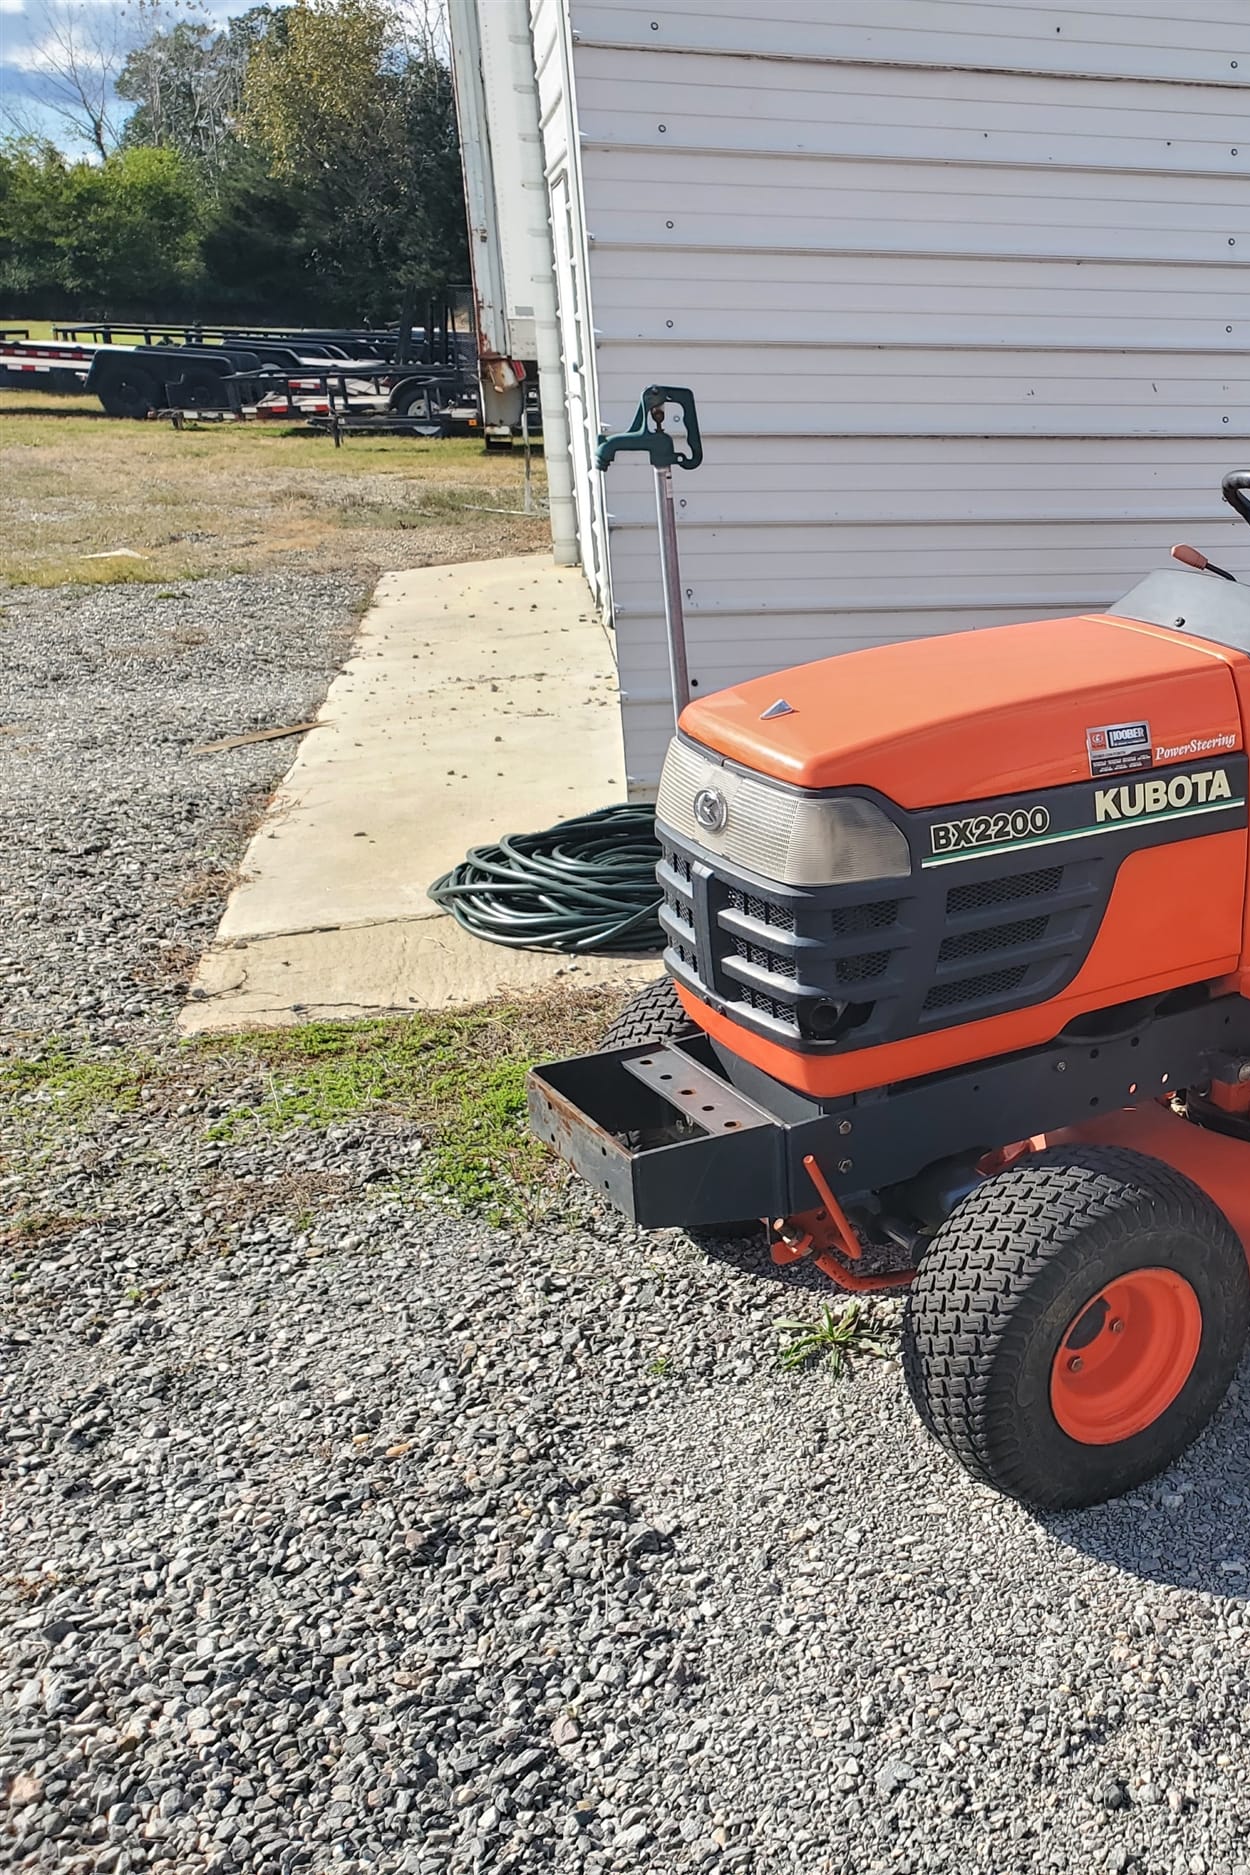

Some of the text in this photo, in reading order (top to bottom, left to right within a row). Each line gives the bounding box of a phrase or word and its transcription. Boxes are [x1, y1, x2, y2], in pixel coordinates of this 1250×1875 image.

[1155, 732, 1236, 761] PowerSteering
[1095, 769, 1231, 822] KUBOTA
[931, 806, 1049, 853] BX2200
